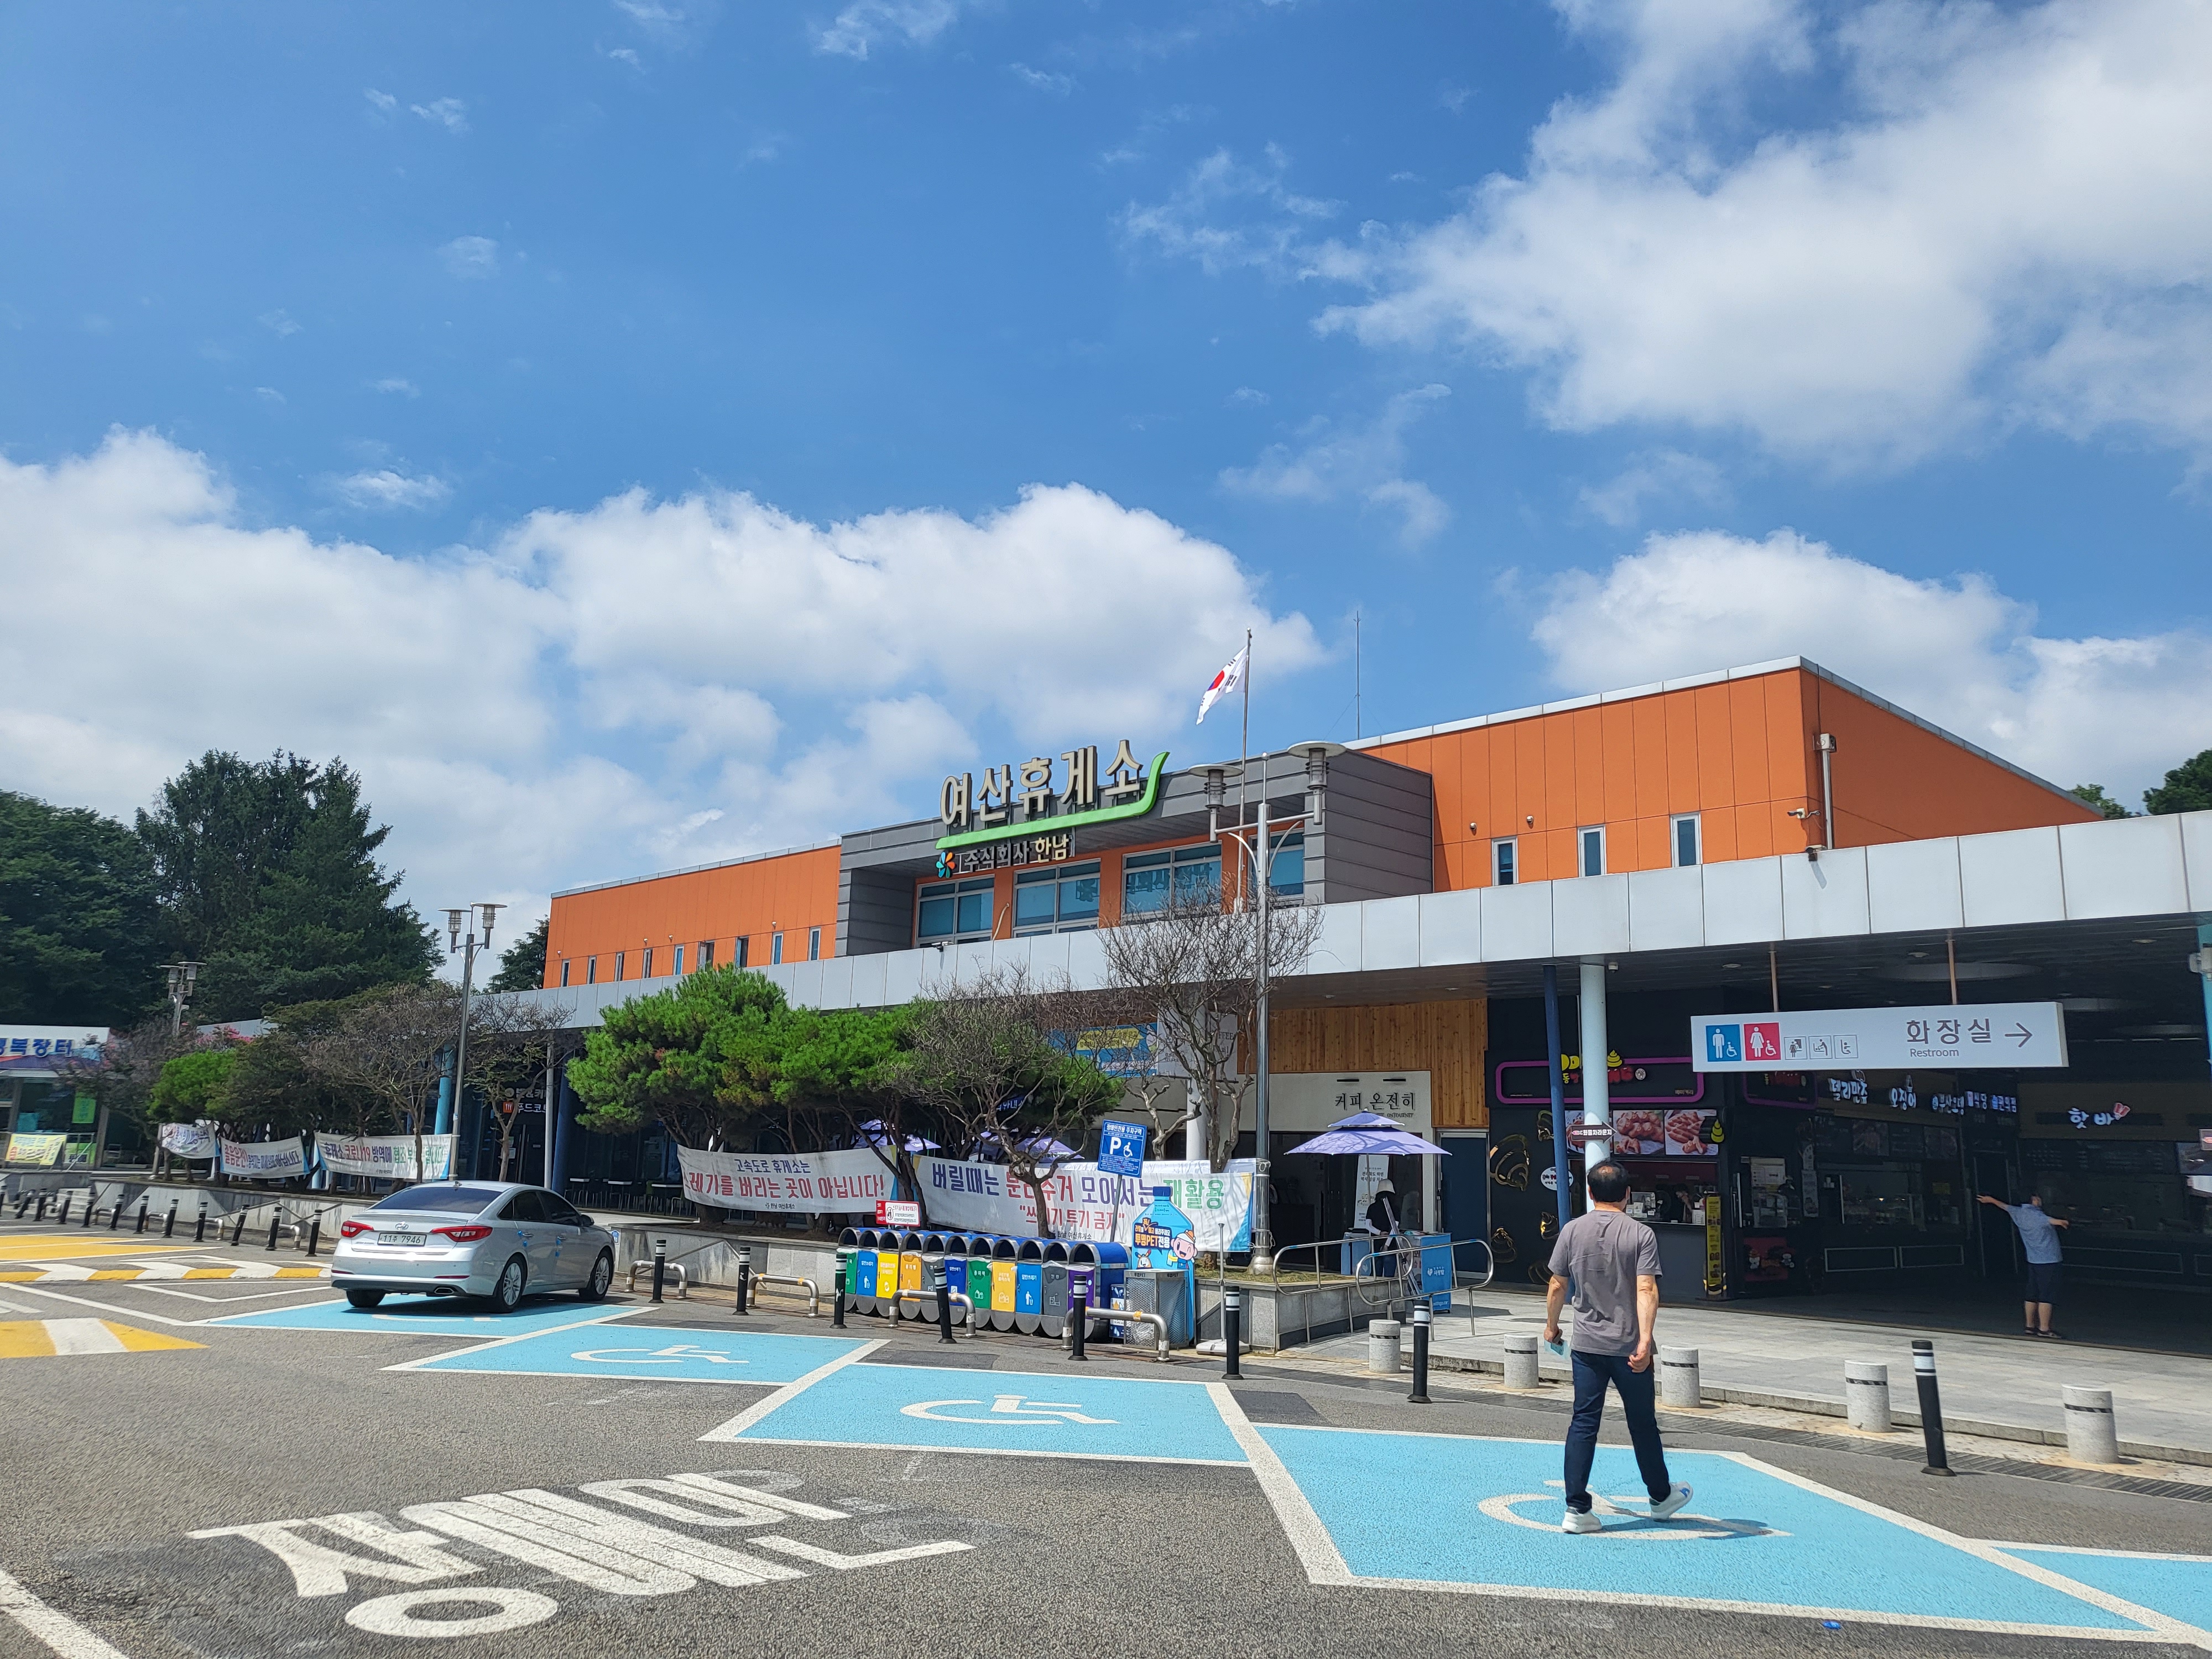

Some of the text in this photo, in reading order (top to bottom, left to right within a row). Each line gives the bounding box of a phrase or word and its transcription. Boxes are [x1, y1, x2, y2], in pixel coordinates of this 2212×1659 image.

[939, 740, 1144, 827] 여산휴게소
[964, 833, 1070, 873] 주식회사 한남
[1906, 1018, 1992, 1045] 화장실
[1910, 1048, 1959, 1057] Restroom
[1335, 1092, 1415, 1111] 커피 온전히
[1828, 1078, 1867, 1104] 델리만쥬
[1891, 1088, 1917, 1110] 오징어
[1107, 1124, 1125, 1133] 장애인전용
[1126, 1126, 1142, 1135] 주차구역
[324, 1142, 345, 1160] 휴게소
[345, 1145, 371, 1162] 코로나19
[372, 1145, 392, 1164] 방역에
[393, 1146, 406, 1164] 협조
[1109, 1136, 1121, 1155] P
[734, 1159, 811, 1173] 고속도로 휴게소는
[738, 1176, 781, 1199] 버리는
[785, 1176, 813, 1199] 곳이
[818, 1174, 885, 1199] 아닙니다!
[932, 1162, 1000, 1196] 버릴때는
[1081, 1177, 1154, 1207] 모아서는
[1067, 1208, 1090, 1229] 투기
[401, 1235, 421, 1244] 7946
[1068, 1232, 1092, 1240] 여산휴게소
